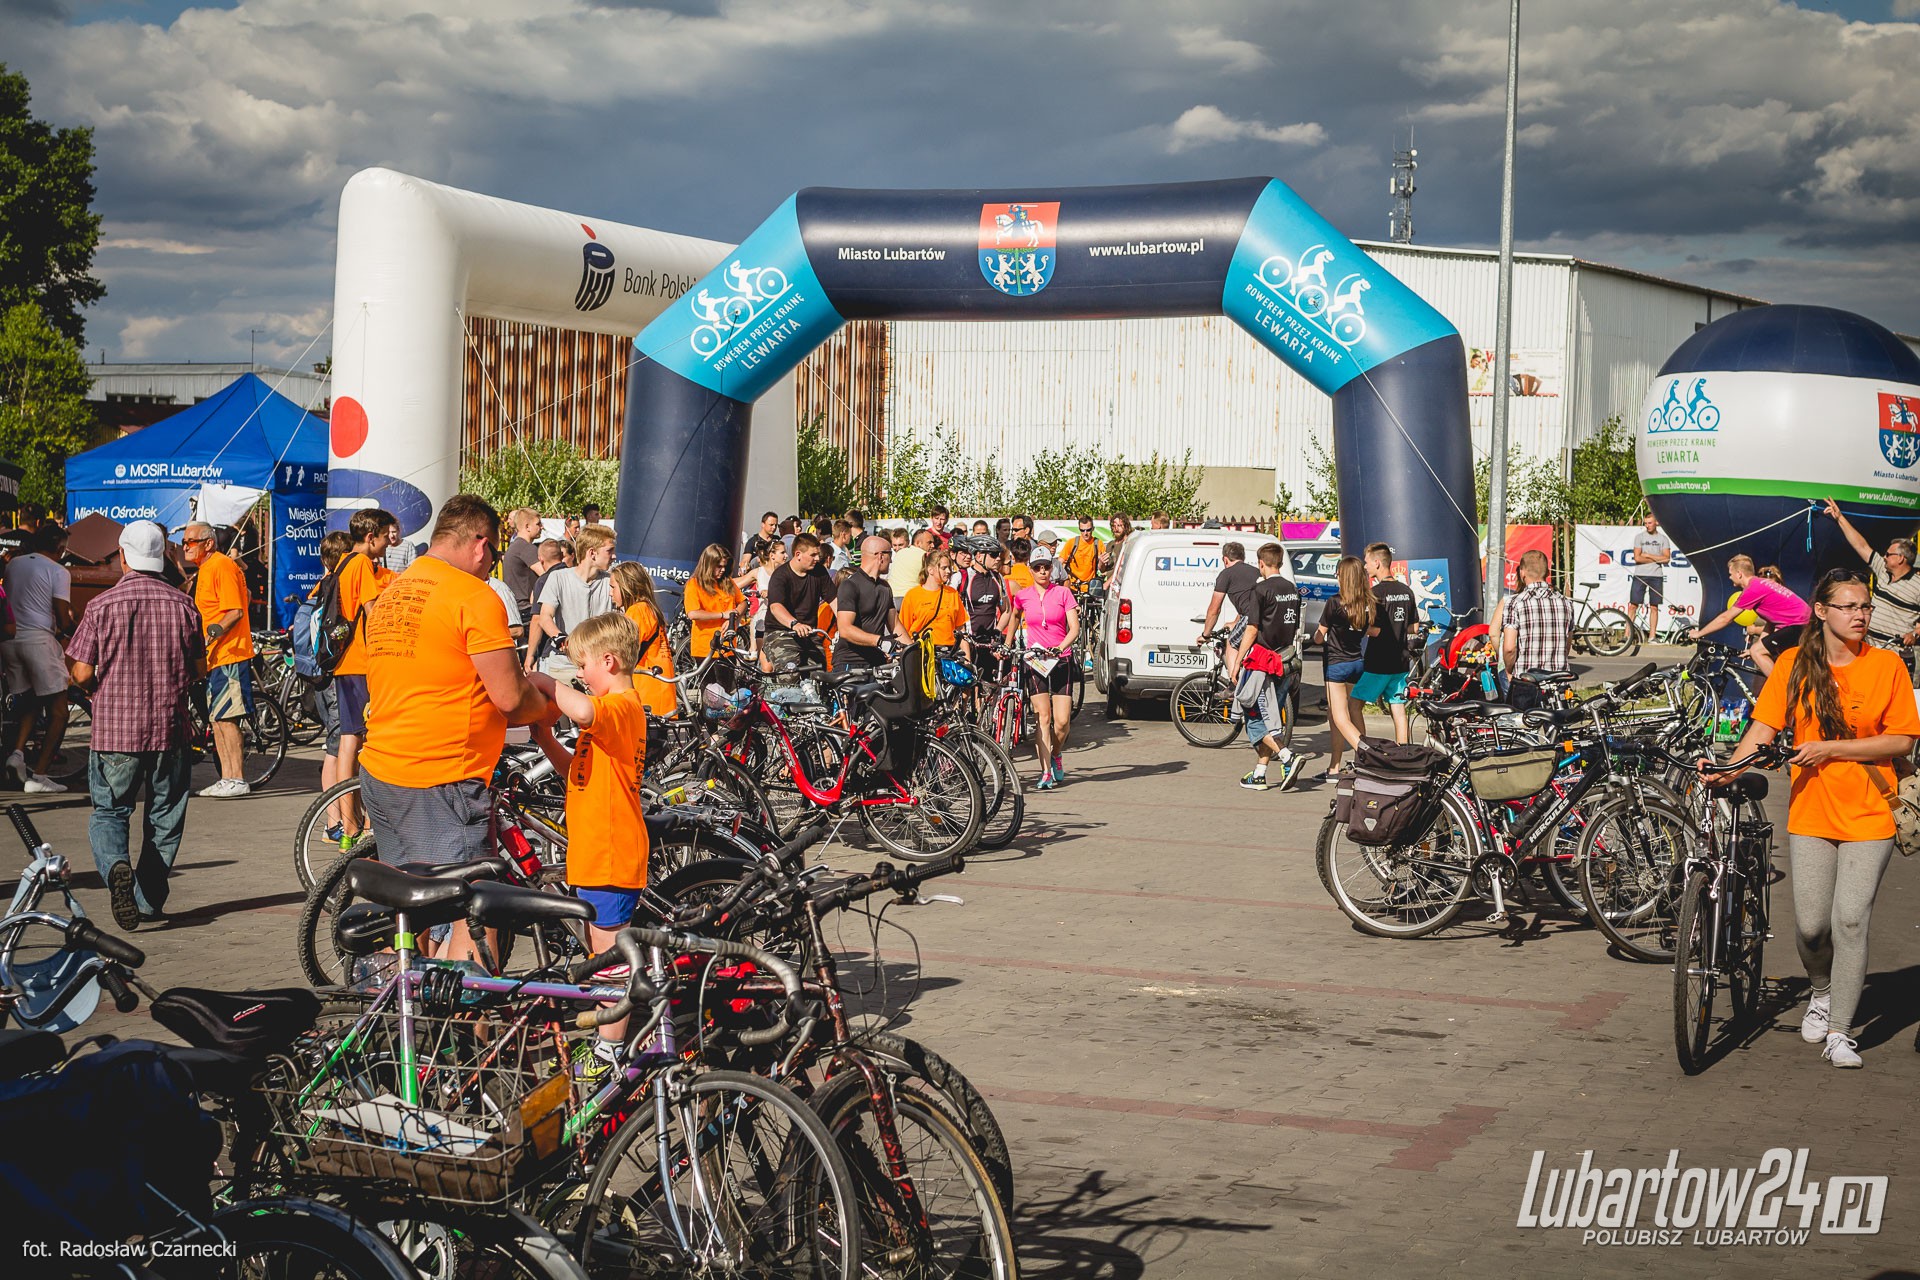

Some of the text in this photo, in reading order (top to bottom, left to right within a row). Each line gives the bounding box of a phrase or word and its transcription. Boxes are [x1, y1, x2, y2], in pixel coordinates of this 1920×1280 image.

[838, 246, 946, 261] Miasto Lubartów
[1089, 238, 1204, 258] www.lubartow.pl
[623, 267, 657, 297] Bank
[1245, 284, 1285, 319] ROWEREM
[1284, 316, 1311, 340] PRZEZ
[741, 318, 801, 369] LEWARTA
[1254, 309, 1314, 363] LEWARTA
[713, 338, 752, 372] ROWEREM
[750, 317, 776, 341] PRZEZ
[1670, 439, 1689, 447] PRZEZ
[1657, 450, 1699, 463] LEWARTA
[130, 463, 223, 477] MOSiR Lubartów
[1873, 470, 1918, 482] Miasto Lubartów
[1657, 481, 1710, 492] www.lubartow.pl
[1859, 492, 1918, 506] www.lubartow.pl
[74, 505, 158, 520] Mieki Ośrodek
[288, 507, 319, 523] Miejski
[285, 525, 318, 541] Sportu
[1174, 557, 1219, 567] LUVI
[1621, 549, 1692, 568] GS
[978, 594, 994, 604] 4F
[1156, 653, 1205, 666] LU 3559W
[1529, 797, 1570, 843] HERCULES
